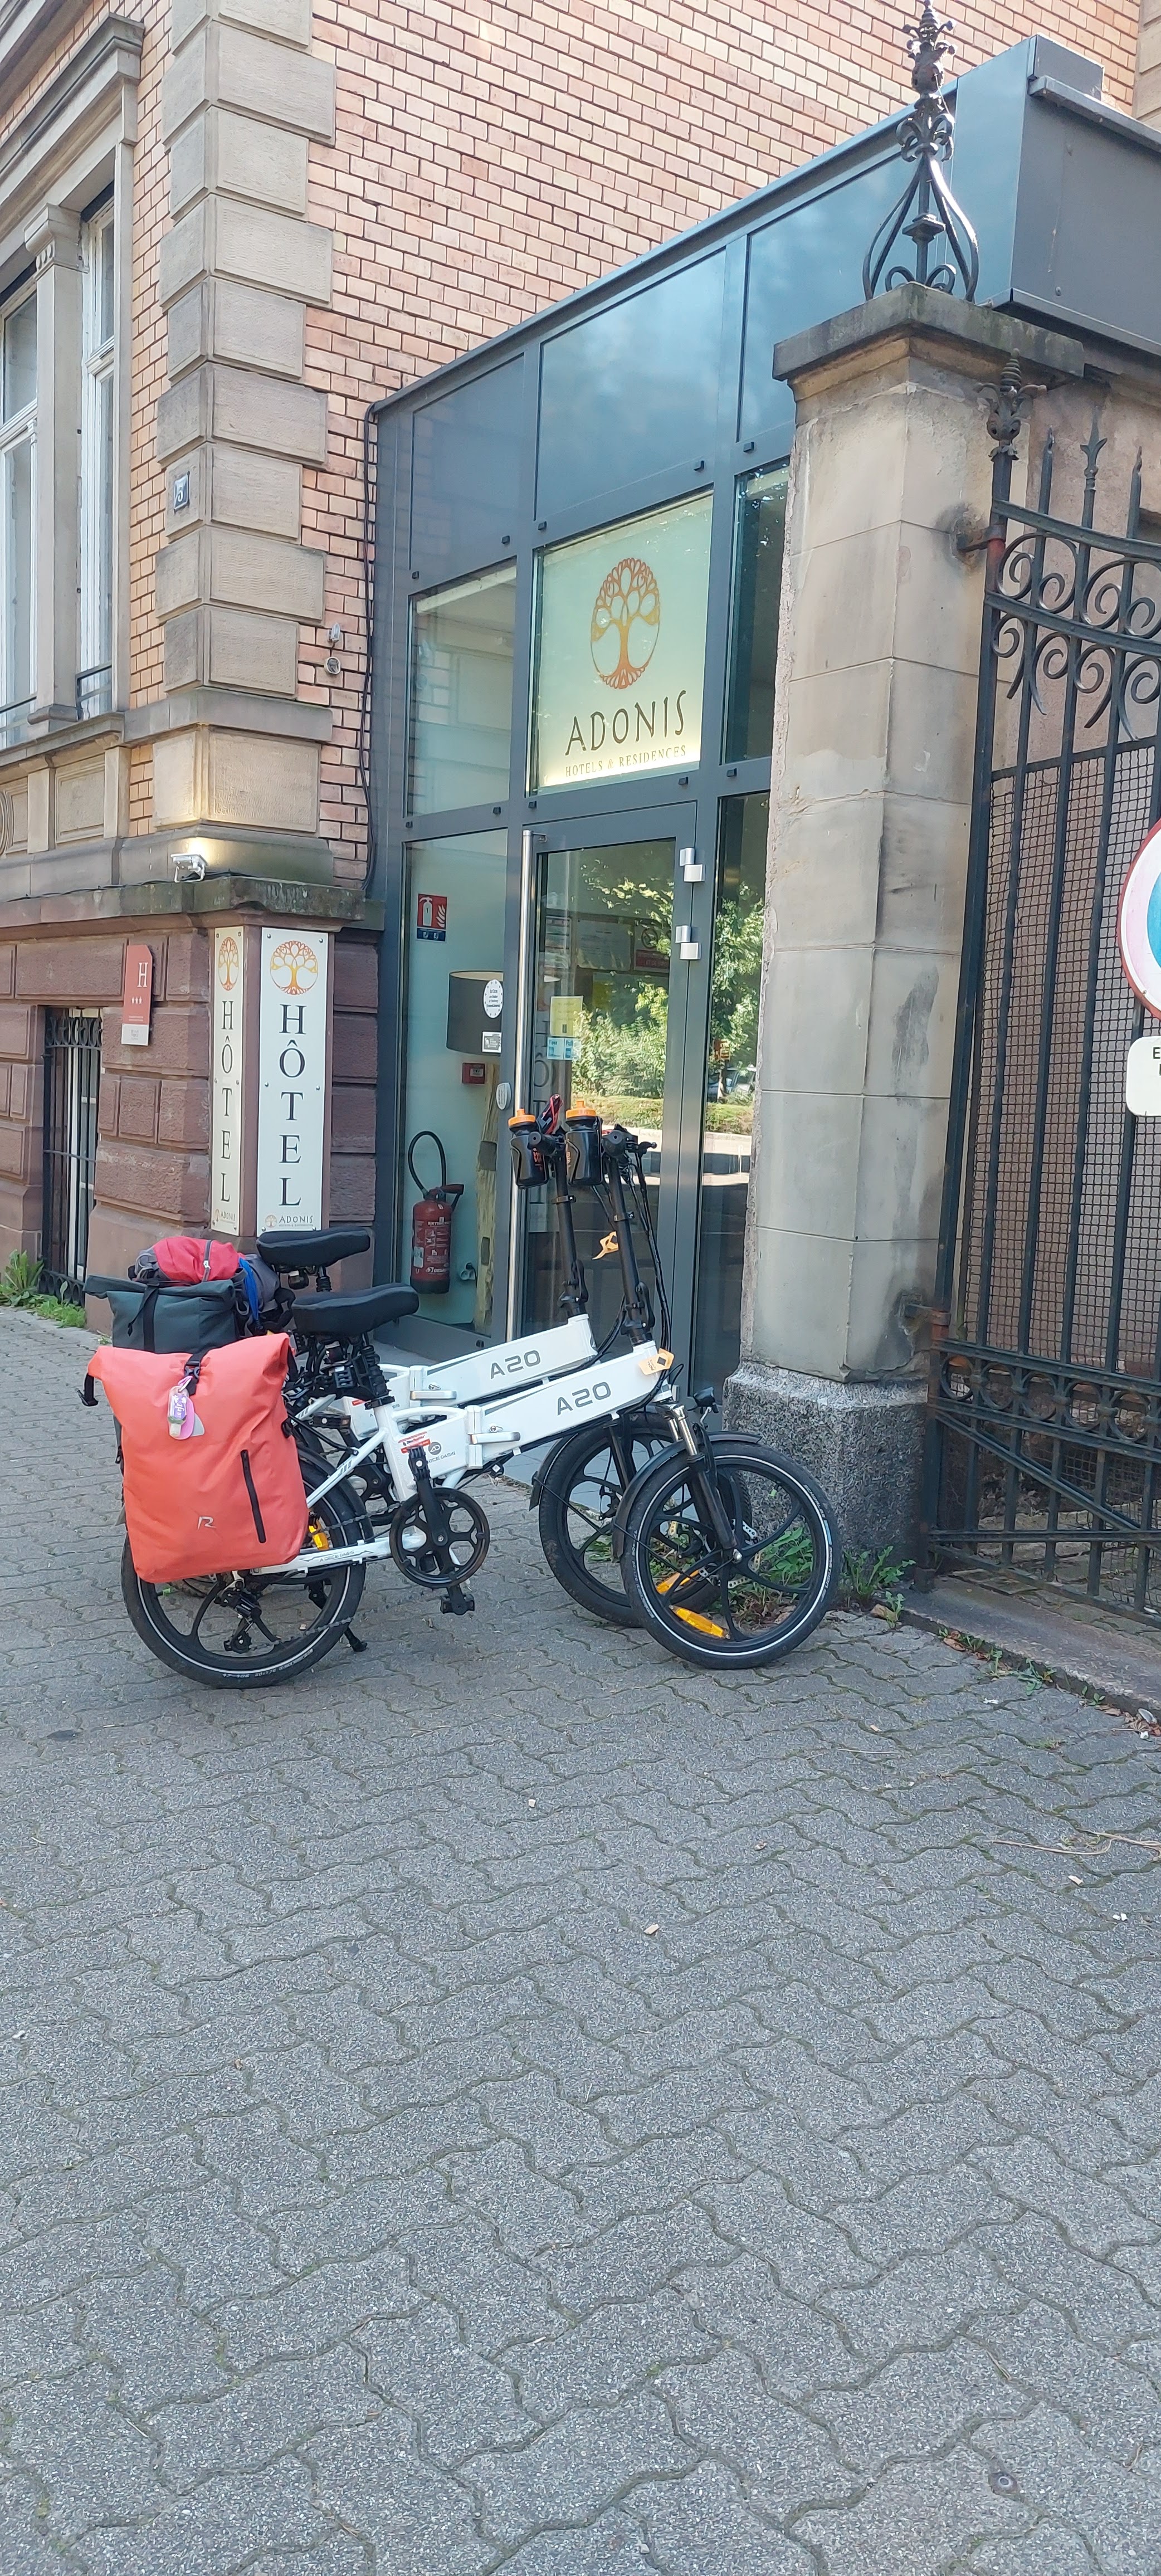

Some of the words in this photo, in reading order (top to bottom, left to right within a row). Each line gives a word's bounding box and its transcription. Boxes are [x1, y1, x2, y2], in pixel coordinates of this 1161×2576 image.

[565, 690, 686, 755] ADONIS
[565, 759, 603, 777] HOTELS
[607, 758, 614, 769] &
[619, 745, 686, 767] RESIDENCES
[137, 962, 149, 988] H
[220, 1000, 235, 1202] HÔTEL
[279, 1004, 306, 1206] HÔTEL
[220, 1211, 236, 1221] ADONIS
[279, 1214, 314, 1223] ADONIS
[490, 1350, 541, 1379] A20
[557, 1382, 611, 1416] A20
